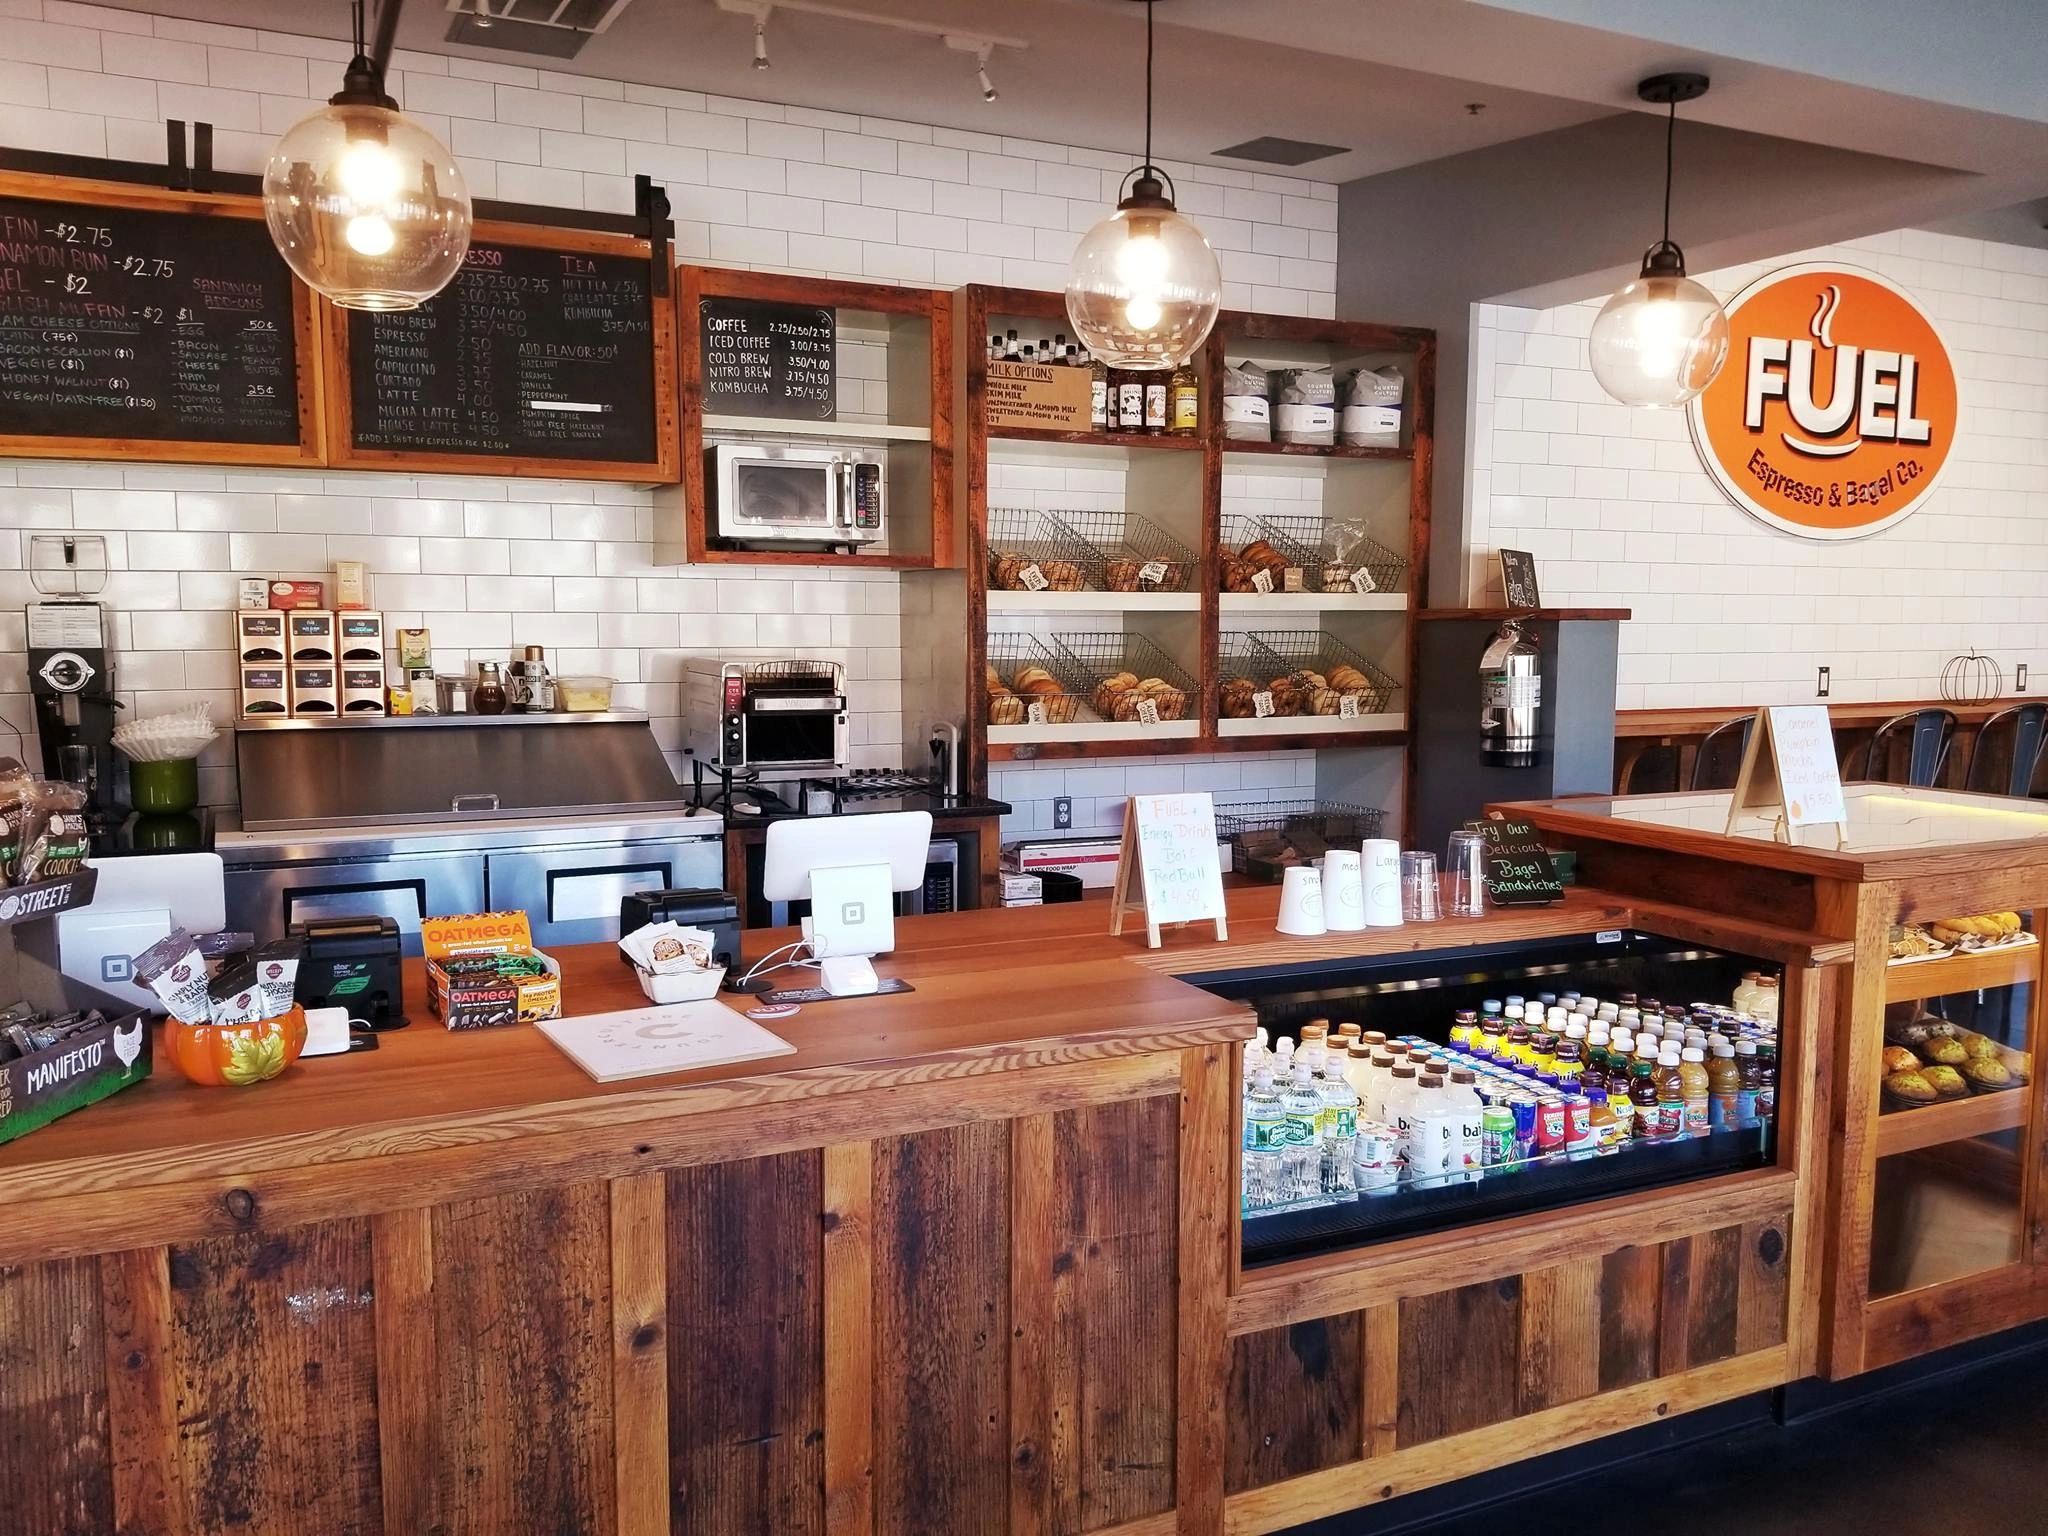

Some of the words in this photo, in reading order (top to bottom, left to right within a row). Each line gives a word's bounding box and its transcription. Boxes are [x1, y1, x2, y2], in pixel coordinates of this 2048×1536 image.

[0, 216, 38, 240] FIN
[71, 249, 109, 272] BUN
[560, 255, 596, 273] TEA
[0, 268, 30, 292] EL
[192, 278, 262, 296] SANDWICH
[0, 296, 48, 312] LISH
[60, 302, 125, 318] MUFFIN
[30, 316, 85, 328] CHEESE
[372, 313, 406, 328] NITRO
[409, 316, 437, 330] BREW
[708, 317, 747, 333] COFFEE
[179, 327, 204, 336] EGG
[374, 327, 426, 343] ESPRESSO
[178, 340, 219, 350] BACON
[519, 343, 541, 355] ADD
[710, 335, 734, 348] ICED
[737, 336, 771, 349] COFFEE
[178, 350, 228, 361] SAUSAGE
[374, 344, 429, 359] AMERICANO
[708, 352, 736, 364] COLD
[740, 353, 770, 365] BREW
[178, 361, 220, 370] CHEESE
[375, 358, 436, 376] CAPPUCCINO
[709, 366, 740, 378] NITRO
[744, 366, 772, 379] BREW
[986, 362, 1011, 377] MILK
[1014, 365, 1054, 380] OPTIONS
[2, 373, 50, 385] HONEY
[54, 376, 106, 387] WALNUT
[179, 372, 206, 381] HAM
[376, 373, 422, 388] CORTADO
[178, 383, 220, 392] TURKEY
[521, 382, 552, 390] VANILLA
[710, 381, 769, 394] KOMBUCHA
[1011, 383, 1027, 392] MILK
[1744, 336, 1931, 446] FUEL
[378, 389, 420, 401] LATTE
[521, 391, 568, 400] PEPPERMINT
[1005, 391, 1022, 400] MILK
[378, 405, 417, 417] MOCHA
[423, 407, 458, 419] LATTE
[1034, 403, 1059, 412] ALMOND
[1061, 405, 1078, 414] MILK
[1025, 410, 1051, 420] ALMOND
[1054, 413, 1070, 422] MILK
[378, 420, 415, 432] HOUSE
[423, 420, 460, 434] LATTE
[1747, 448, 1824, 507] Espresso
[1828, 482, 1842, 507] &
[1846, 470, 1894, 506] Bagel
[1896, 459, 1924, 486] Co.
[1467, 822, 1499, 841] Try
[1507, 823, 1529, 835] Our
[1484, 842, 1545, 856] Delicious
[1491, 859, 1542, 879] Bagel
[1487, 880, 1562, 894] Sandwiches
[17, 884, 67, 916] STREET
